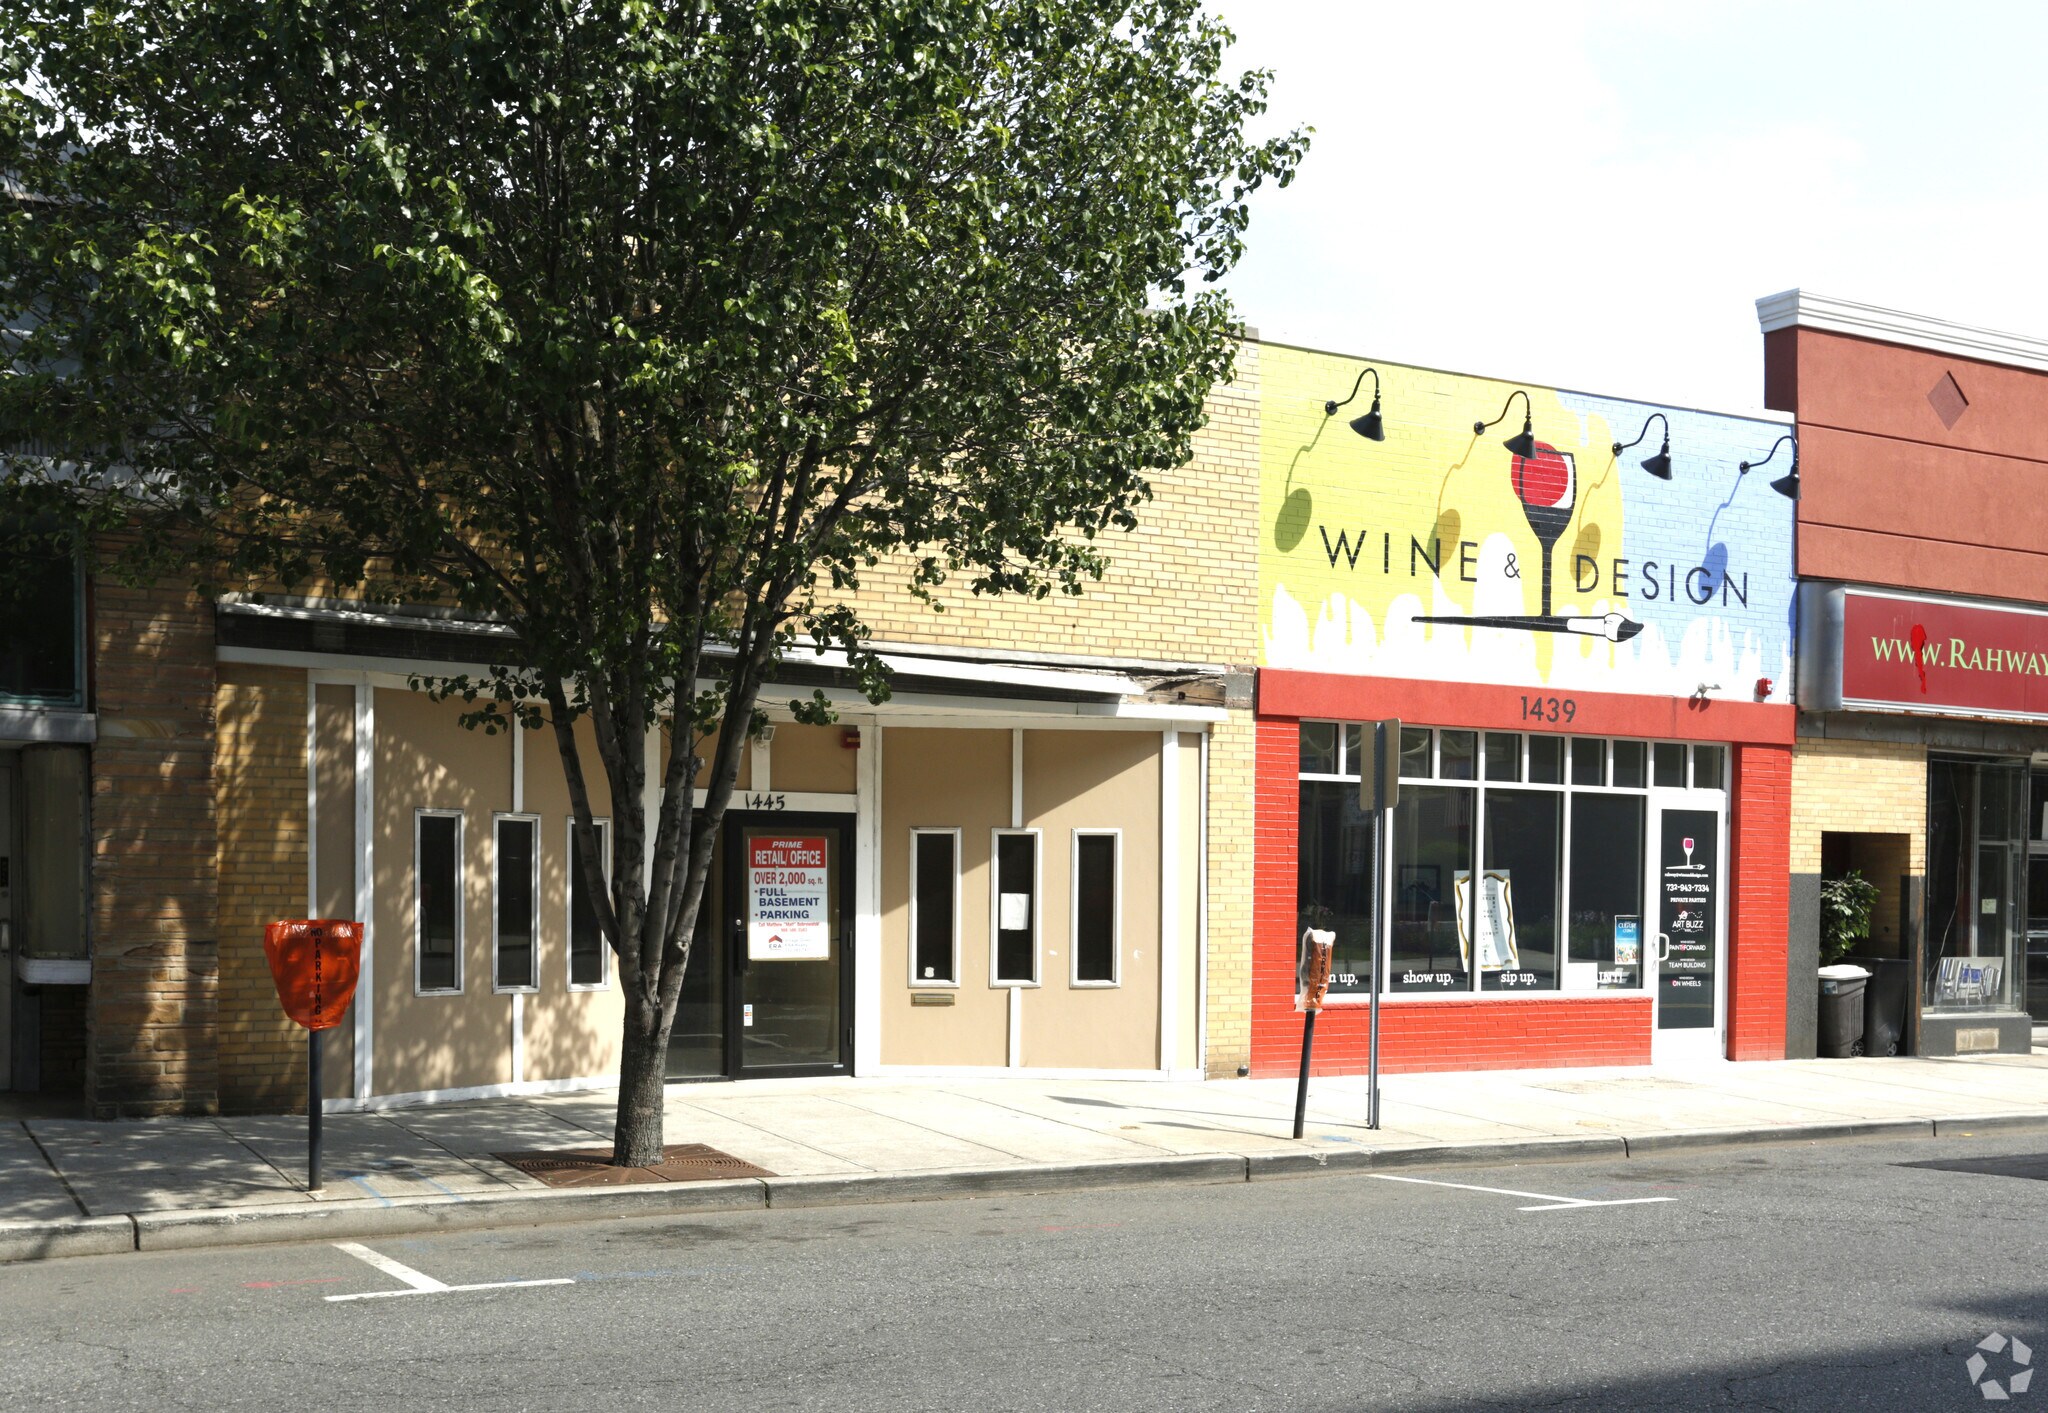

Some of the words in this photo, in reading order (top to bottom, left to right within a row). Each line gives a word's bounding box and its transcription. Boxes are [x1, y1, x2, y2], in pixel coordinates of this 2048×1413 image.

[1319, 525, 1478, 582] WINE
[1504, 553, 1521, 579] &
[1576, 554, 1748, 609] DESIGN
[1520, 695, 1576, 723] 1439
[745, 792, 785, 811] 1445
[790, 850, 821, 865] OFFICE
[754, 871, 777, 885] OVER
[779, 872, 806, 887] 2,000
[759, 887, 787, 896] FULL
[759, 898, 819, 906] BASEMENT
[760, 910, 810, 919] PARKING
[1672, 920, 1685, 928] ART
[1685, 920, 1704, 928] BUZZ
[310, 928, 323, 937] NO
[314, 939, 322, 1015] PARKING
[1339, 973, 1359, 986] up,
[1403, 970, 1434, 983] show
[1436, 973, 1454, 985] up,
[1500, 971, 1517, 985] sip
[1520, 973, 1537, 985] up,
